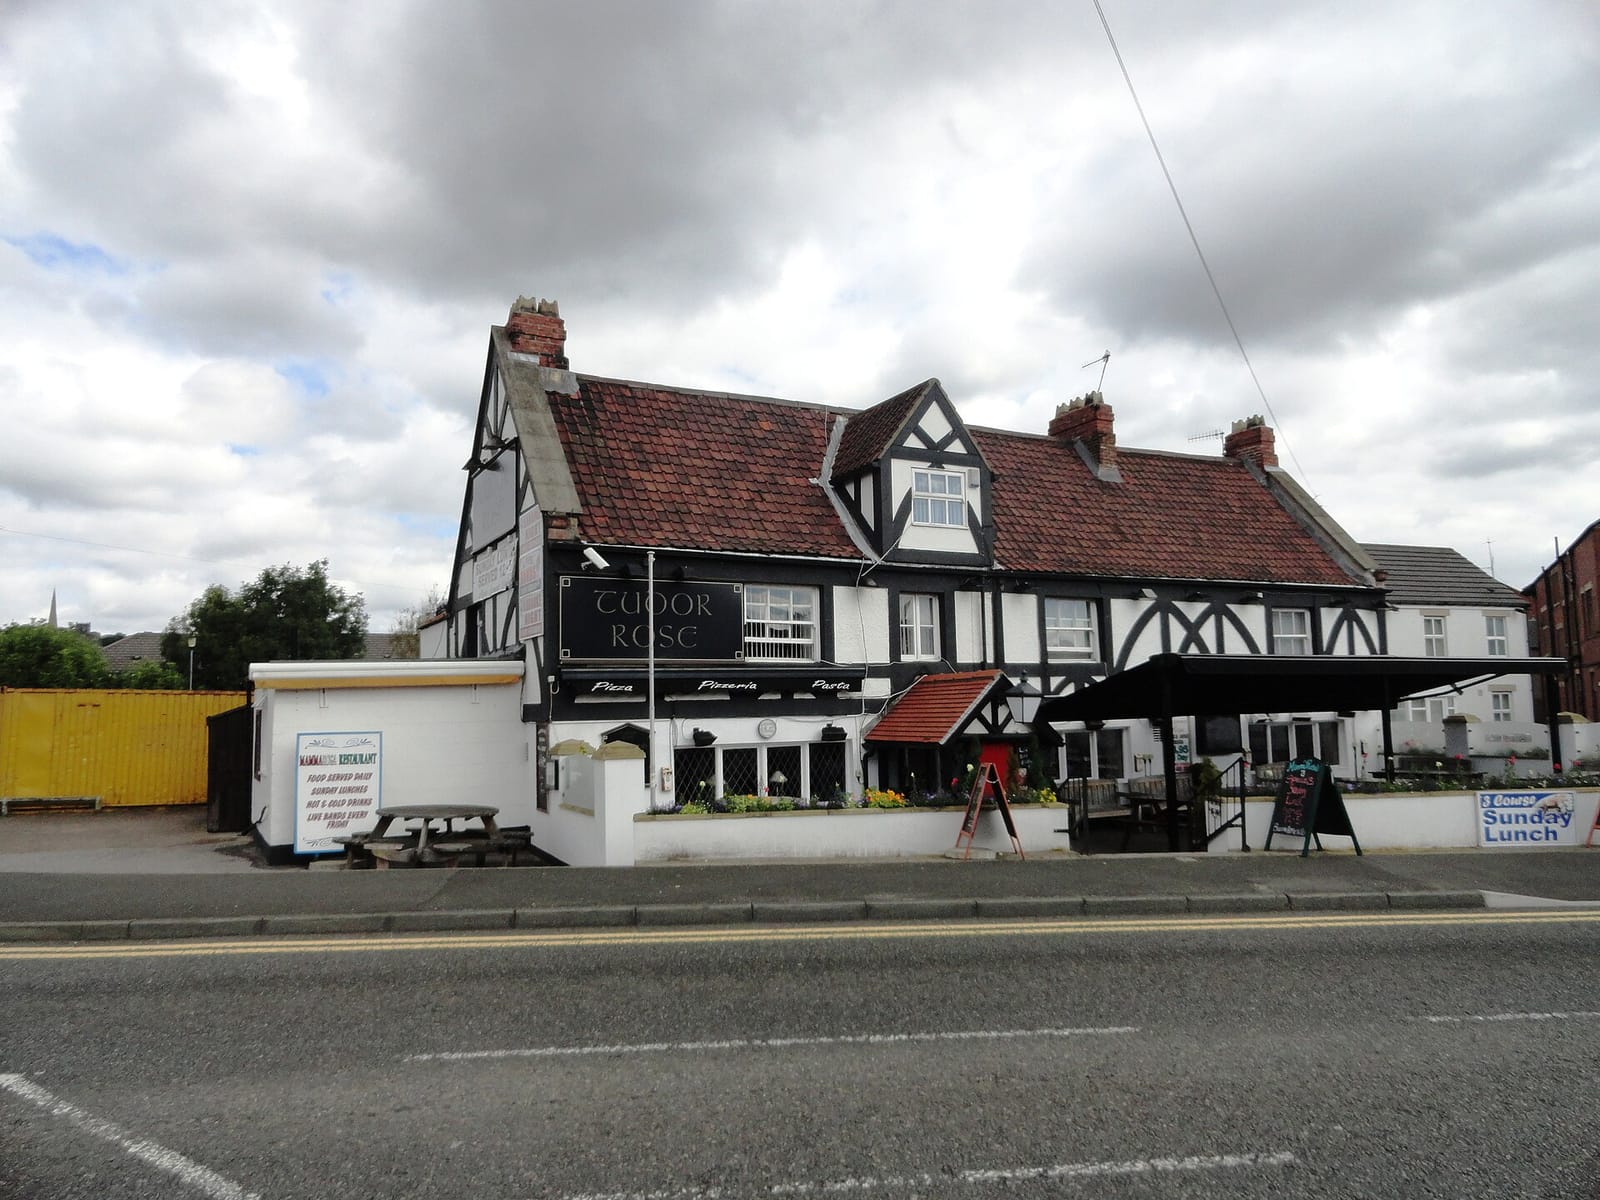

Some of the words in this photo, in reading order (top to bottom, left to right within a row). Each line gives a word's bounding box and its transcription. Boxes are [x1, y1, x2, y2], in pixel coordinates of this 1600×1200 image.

[594, 590, 712, 616] TUDOR
[612, 624, 697, 648] ROSE
[591, 681, 633, 692] Pizza
[698, 680, 757, 690] Pizzeria
[812, 680, 850, 690] Pasta
[339, 753, 377, 765] RESTAURANT
[307, 774, 327, 783] FOOD
[327, 773, 353, 782] SERVED
[354, 772, 373, 781] DAILY
[311, 787, 338, 795] SUNDAY
[338, 785, 368, 794] LUNCHES
[306, 800, 321, 809] HOT
[328, 799, 346, 808] COLD
[346, 798, 373, 807] DRINKS
[1493, 794, 1537, 806] Course
[306, 812, 322, 821] LIVE
[322, 811, 346, 820] BANDS
[347, 811, 369, 819] EVERY
[1483, 809, 1572, 828] Sunday
[326, 820, 350, 829] FRIDAY
[1484, 826, 1558, 842] Lunch
